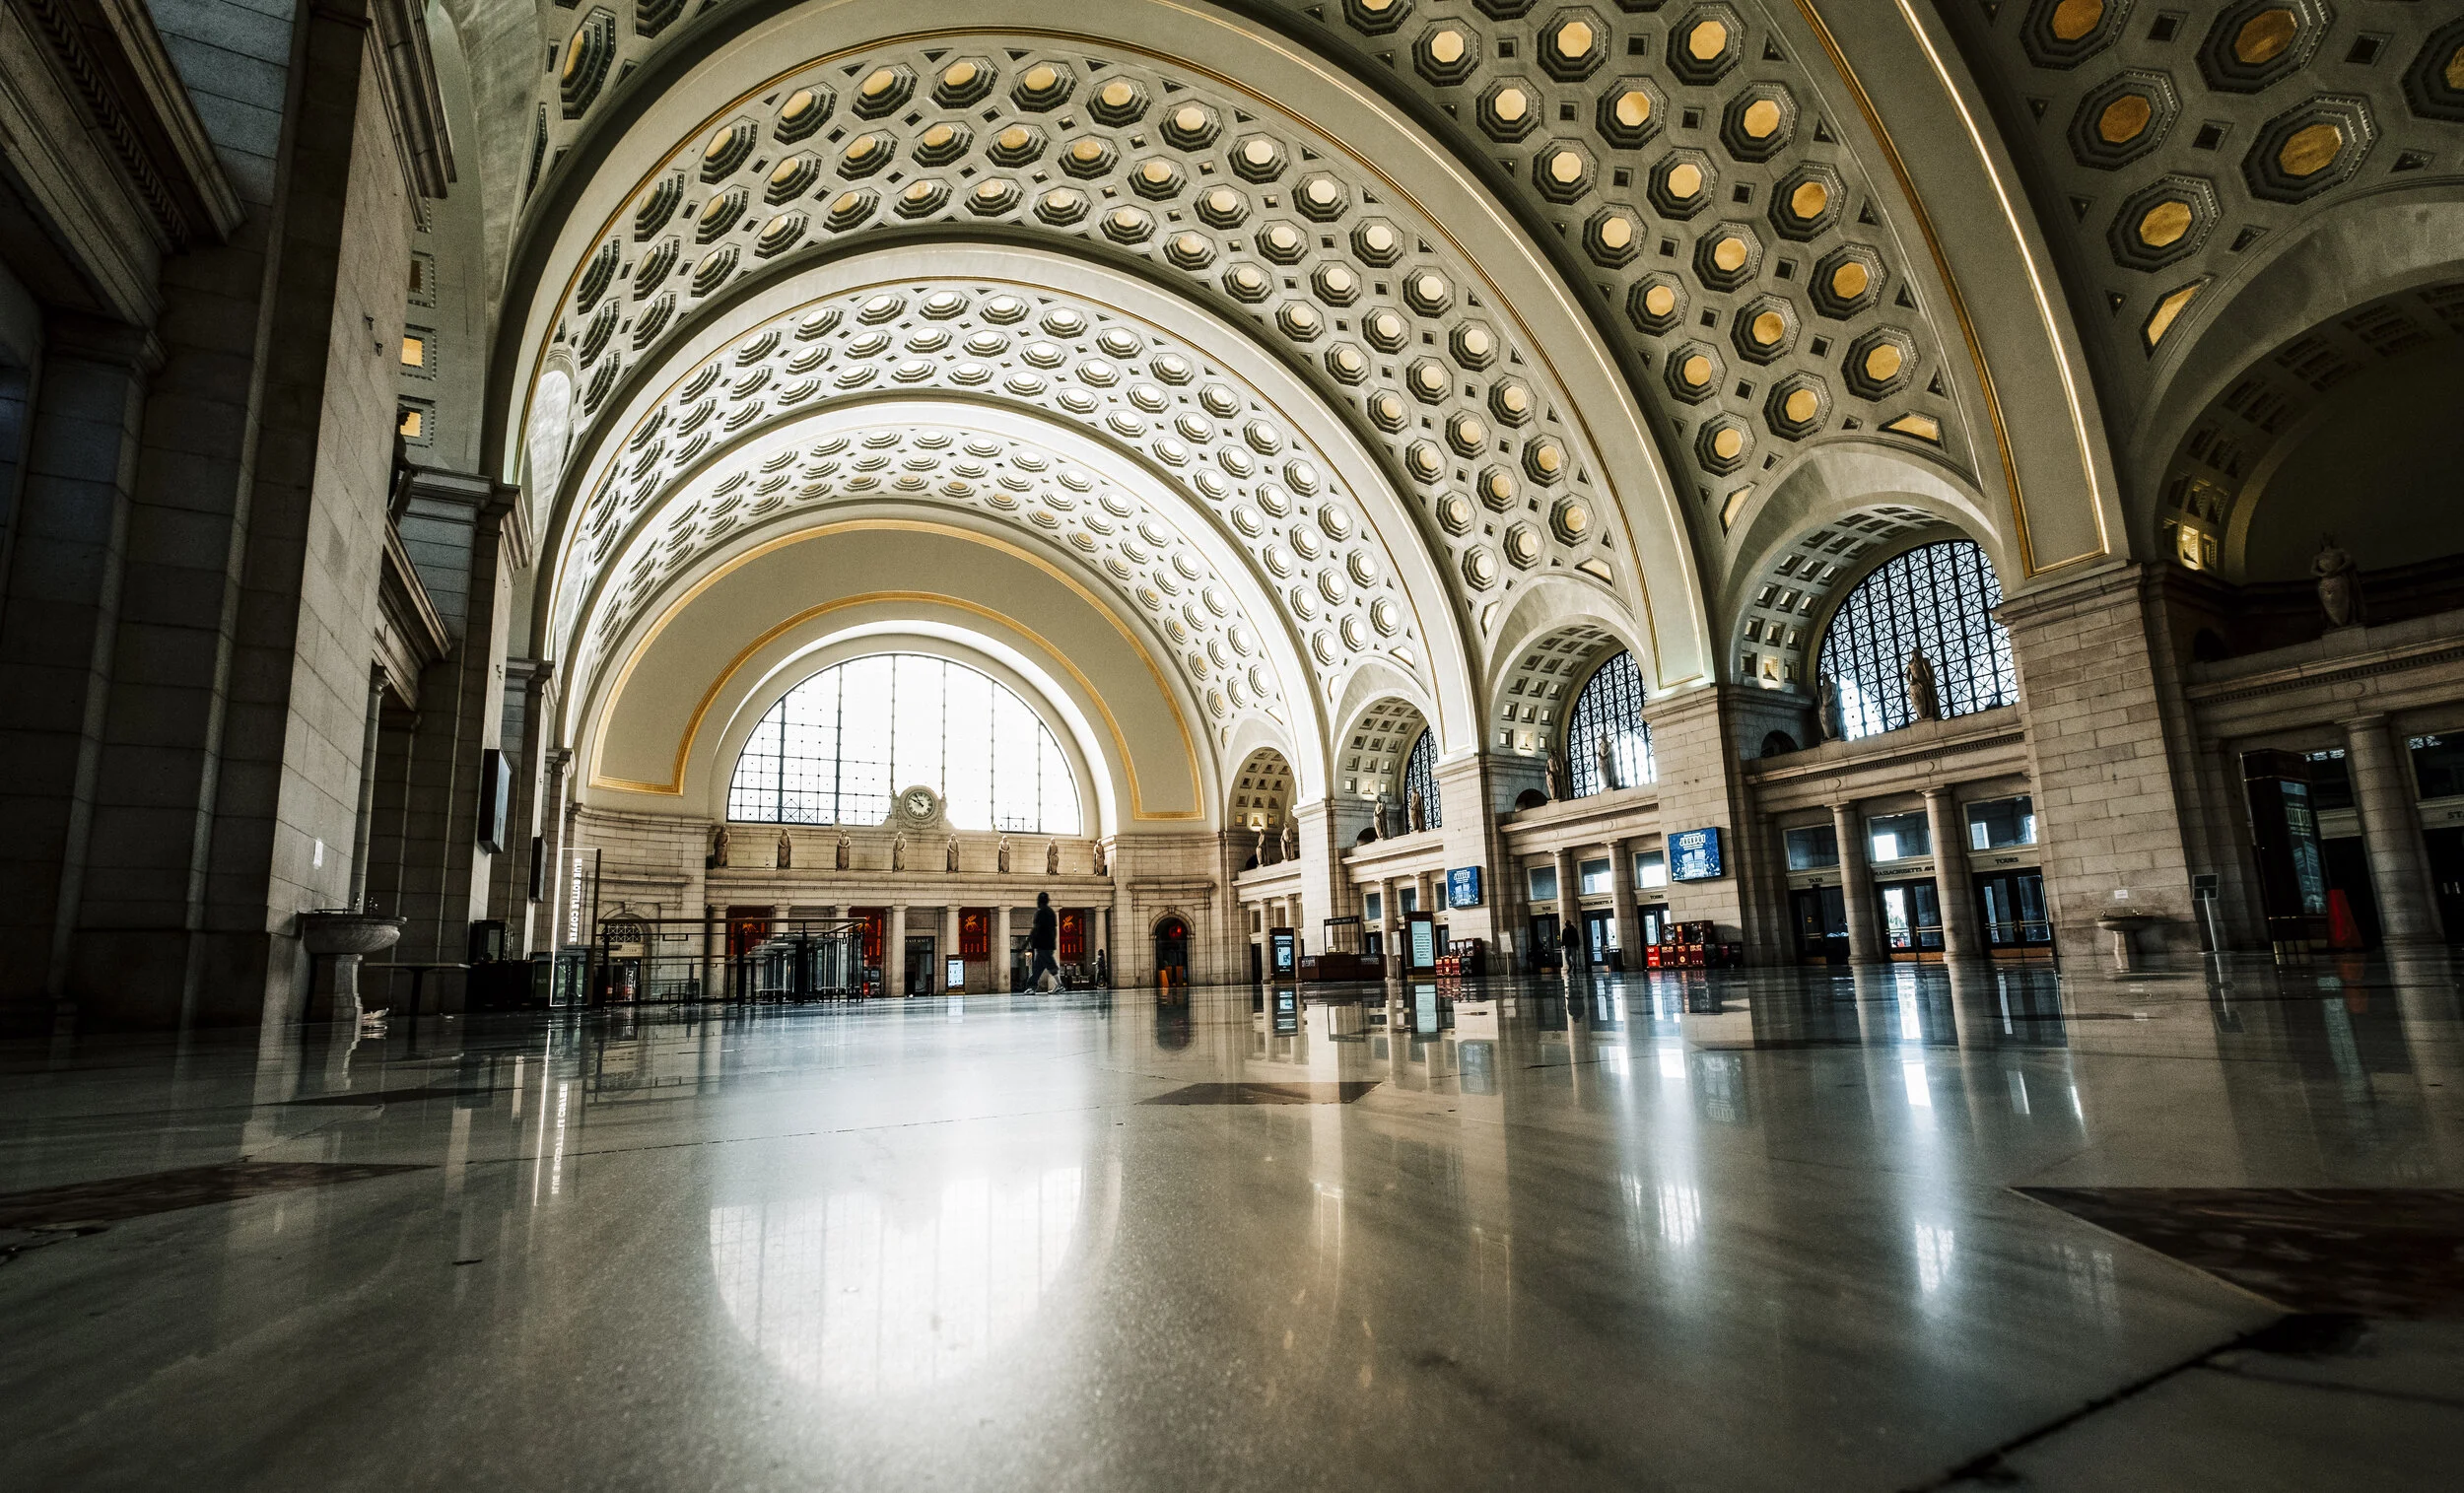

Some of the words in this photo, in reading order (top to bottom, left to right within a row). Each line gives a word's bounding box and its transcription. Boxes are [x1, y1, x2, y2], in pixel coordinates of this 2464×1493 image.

[2447, 810, 2464, 819] ST
[1679, 834, 1706, 847] JACKPOT
[574, 858, 582, 878] BLUE
[572, 879, 581, 909] BOTTLE
[570, 911, 579, 942] COFFEE
